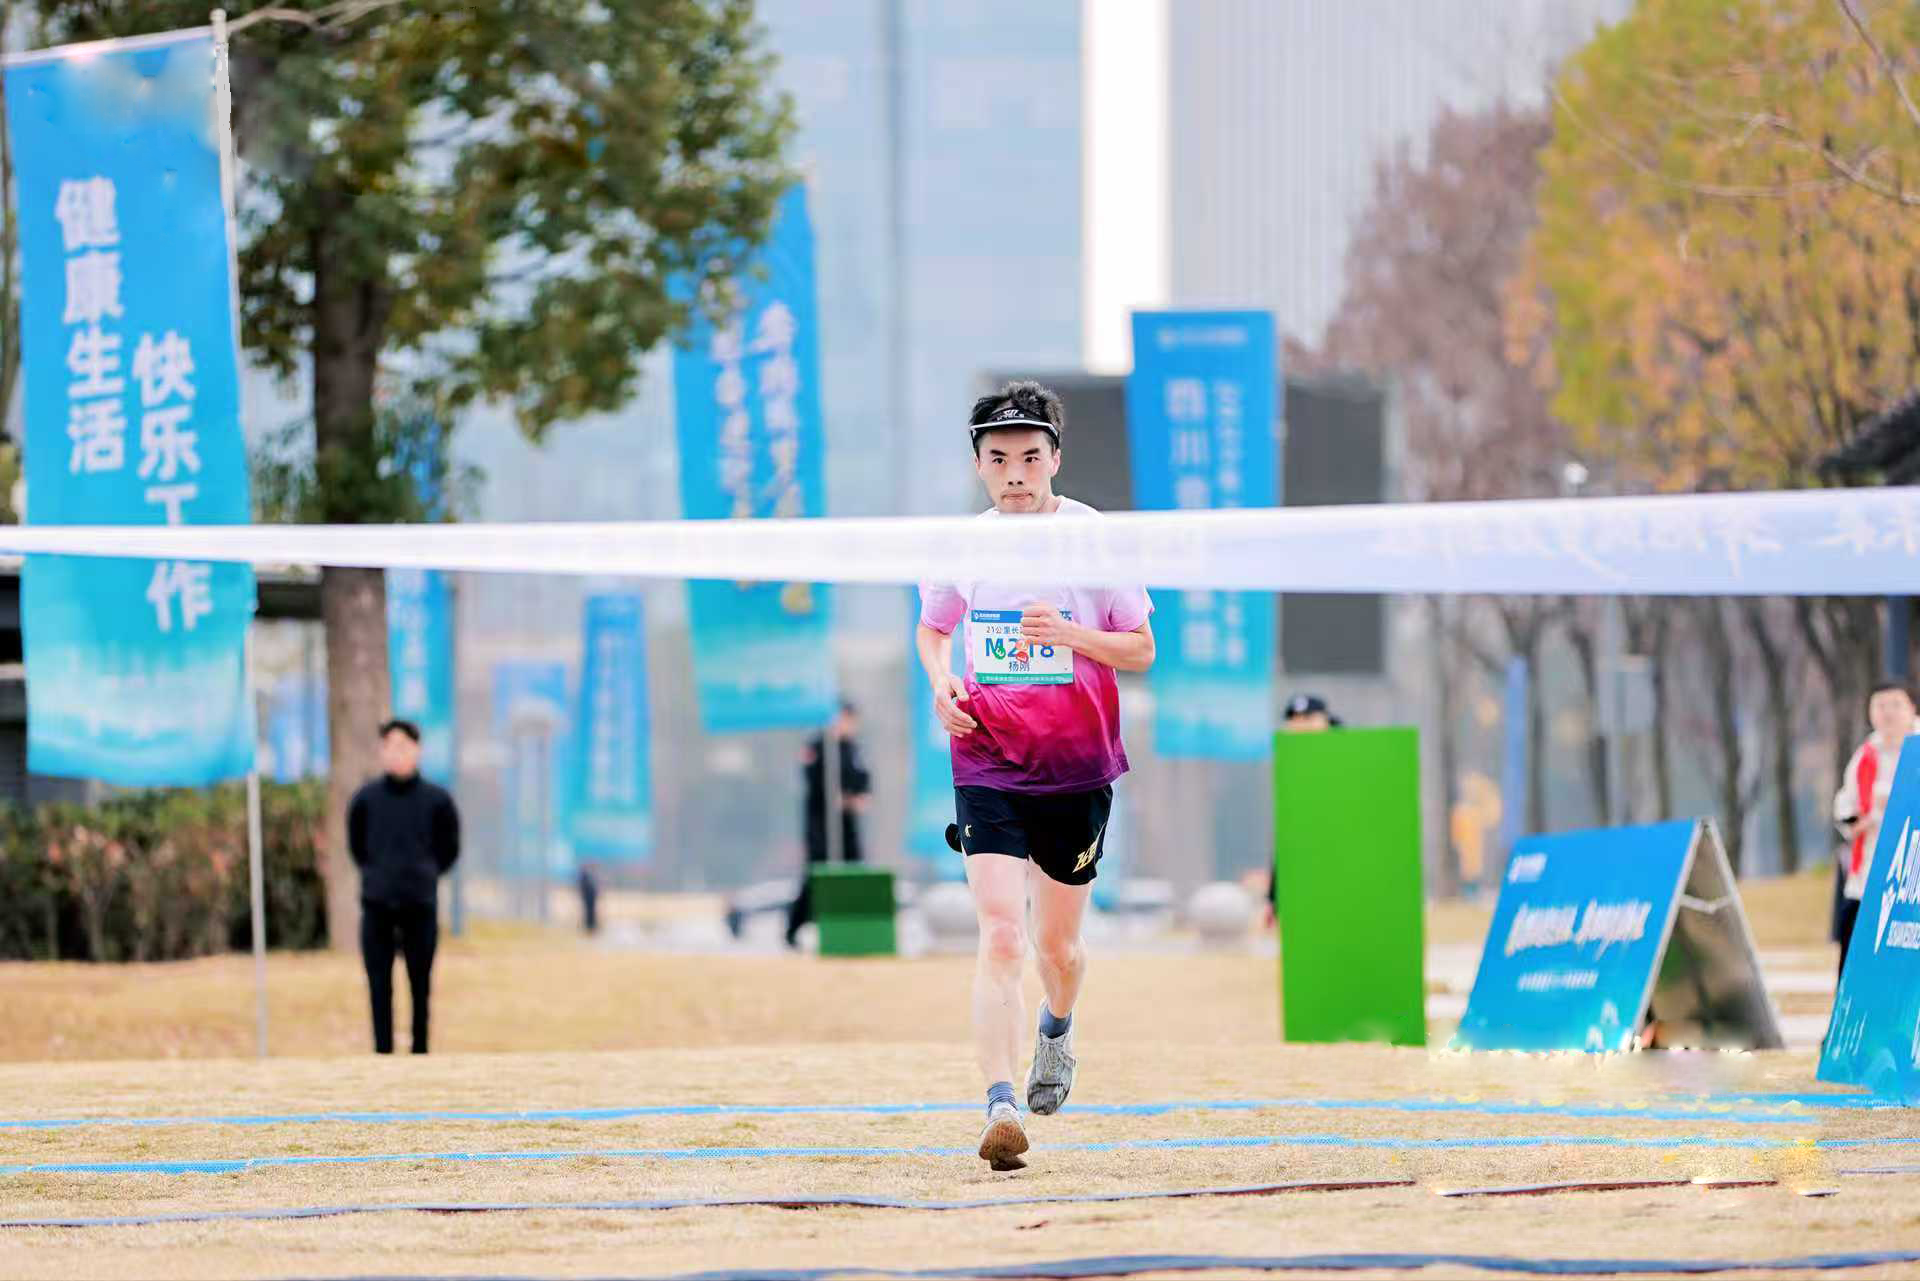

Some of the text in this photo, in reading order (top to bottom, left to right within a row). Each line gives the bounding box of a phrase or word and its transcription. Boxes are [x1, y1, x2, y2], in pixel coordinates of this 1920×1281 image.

[54, 175, 127, 475] 健康生活
[131, 331, 213, 632] 快乐工作
[985, 638, 1055, 657] M218
